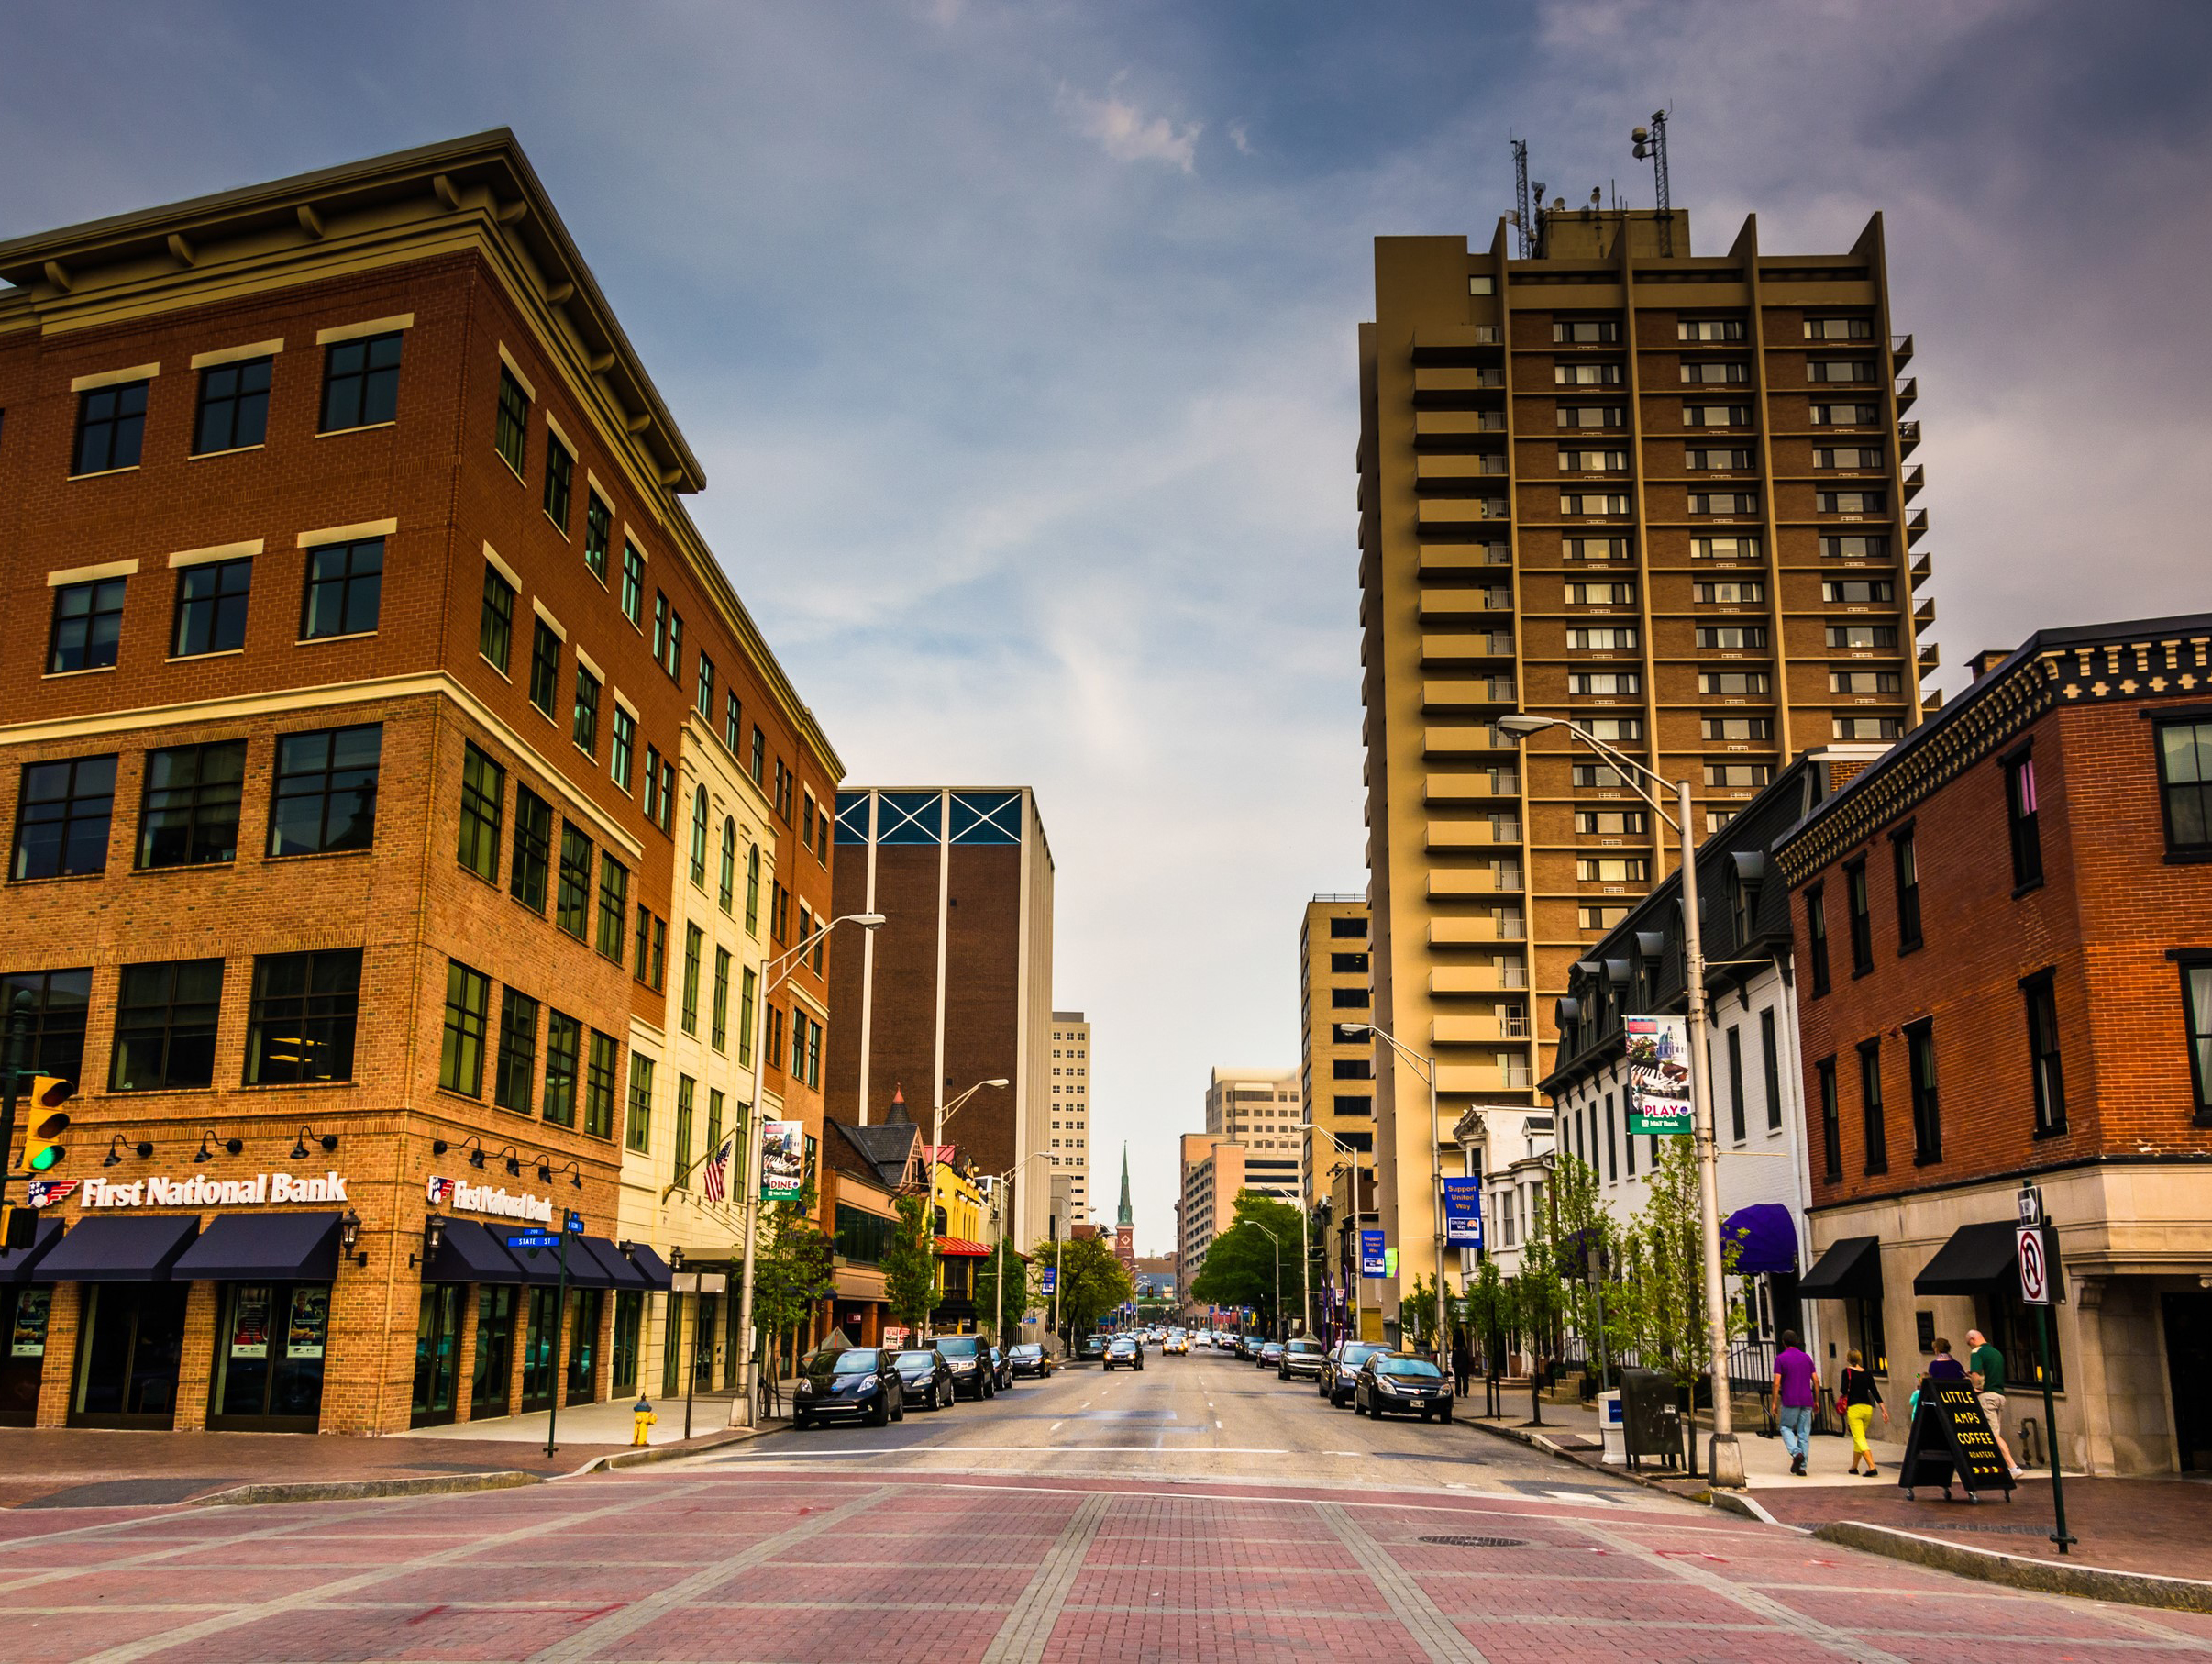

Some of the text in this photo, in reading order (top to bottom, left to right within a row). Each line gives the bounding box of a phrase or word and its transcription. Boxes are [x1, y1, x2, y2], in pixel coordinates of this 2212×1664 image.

[1644, 1105, 1678, 1116] PLAY
[81, 1171, 348, 1208] First National Bank
[770, 1181, 791, 1189] DINE
[453, 1180, 481, 1211] First
[1455, 1203, 1471, 1211] Way
[1940, 1391, 1974, 1403] LITTLE
[1953, 1412, 1980, 1424] AMPS
[1957, 1432, 1994, 1445] COFFEE
